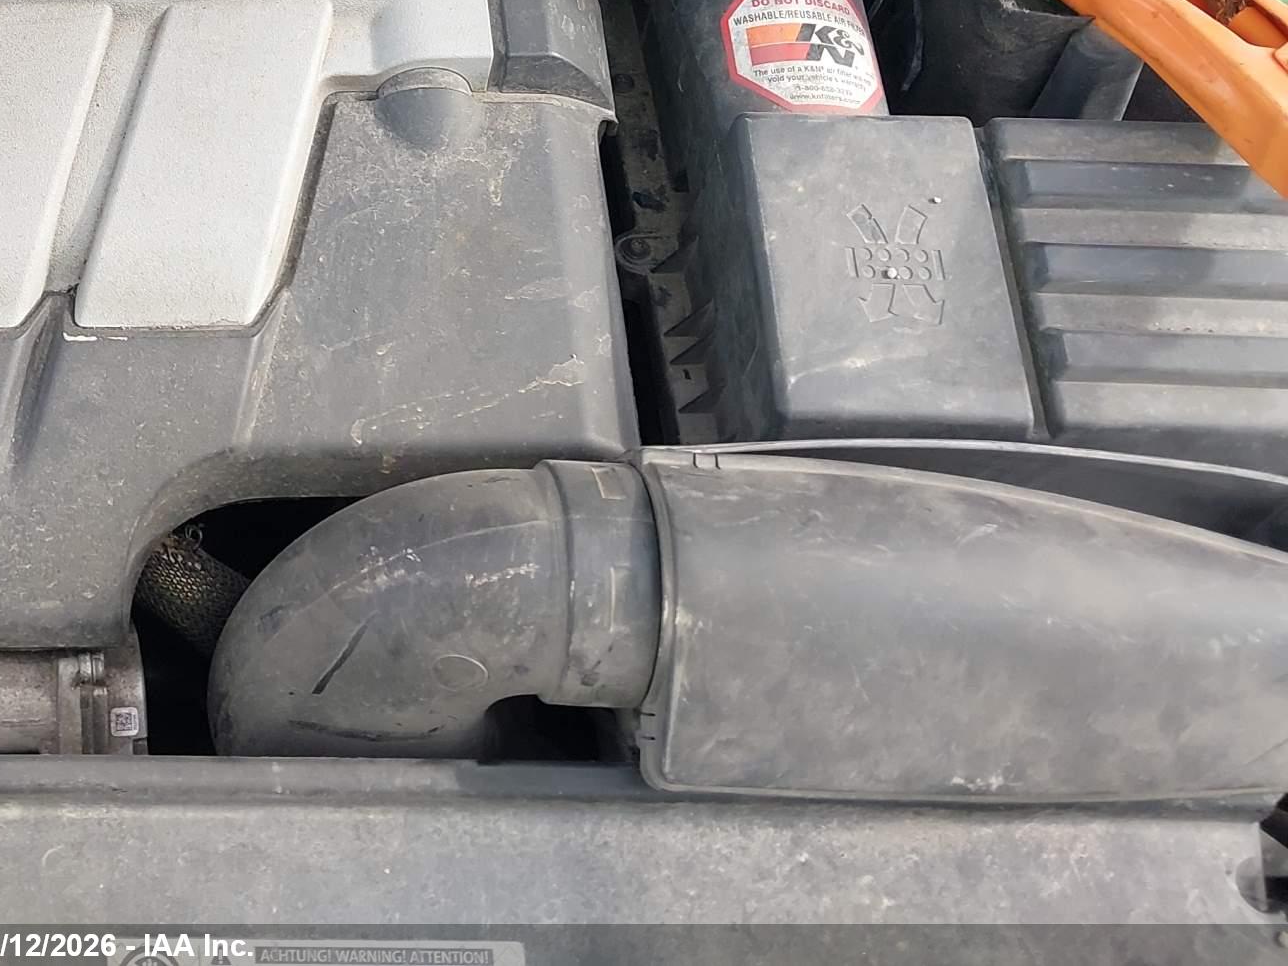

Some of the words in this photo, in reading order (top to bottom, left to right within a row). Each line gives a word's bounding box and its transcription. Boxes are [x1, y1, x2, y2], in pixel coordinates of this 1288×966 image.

[733, 9, 832, 26] WASHABLE/REUSABLE
[795, 23, 865, 68] K&N
[753, 69, 769, 77] The
[260, 948, 332, 963] ACHTUNG!
[334, 949, 407, 963] WARNING!
[410, 950, 490, 964] ATTENTION!
